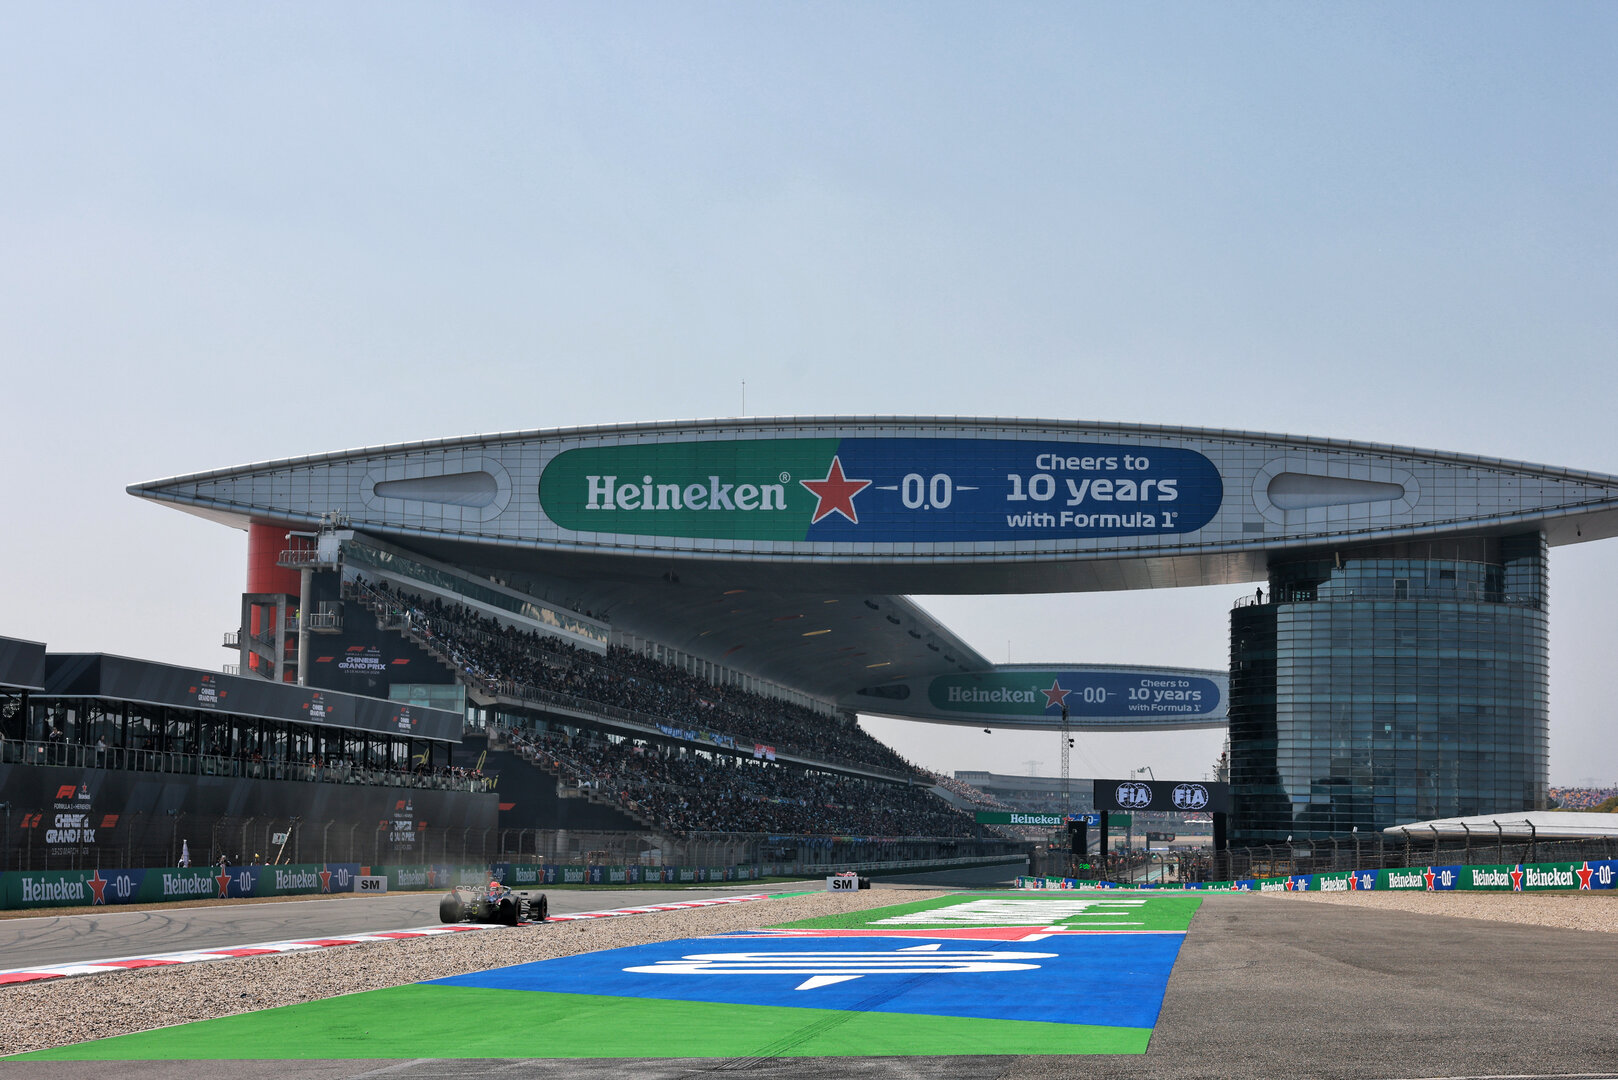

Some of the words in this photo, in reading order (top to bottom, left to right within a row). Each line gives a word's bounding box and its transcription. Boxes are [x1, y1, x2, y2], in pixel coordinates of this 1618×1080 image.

[1036, 453, 1117, 470] Cheers
[1123, 453, 1149, 470] to
[1006, 474, 1056, 501] 10
[1066, 478, 1178, 506] years
[1007, 511, 1054, 528] with
[1060, 512, 1155, 528] Formula
[338, 662, 367, 670] GRAND
[1140, 679, 1176, 688] Cheers
[1178, 679, 1189, 688] to
[948, 686, 1036, 703] Heineken
[1128, 687, 1150, 700] 10
[1153, 689, 1202, 702] years
[1128, 703, 1150, 712] with
[1151, 703, 1192, 712] Formula
[1010, 813, 1061, 824] Heineken
[163, 873, 213, 895] Heineken
[275, 869, 318, 889] Heineken
[360, 879, 380, 892] SM
[832, 879, 853, 890] SM
[1388, 871, 1423, 888] Heineken
[1472, 869, 1509, 886] Heineken
[1525, 868, 1574, 887] Heineken
[22, 877, 85, 902] Heineken
